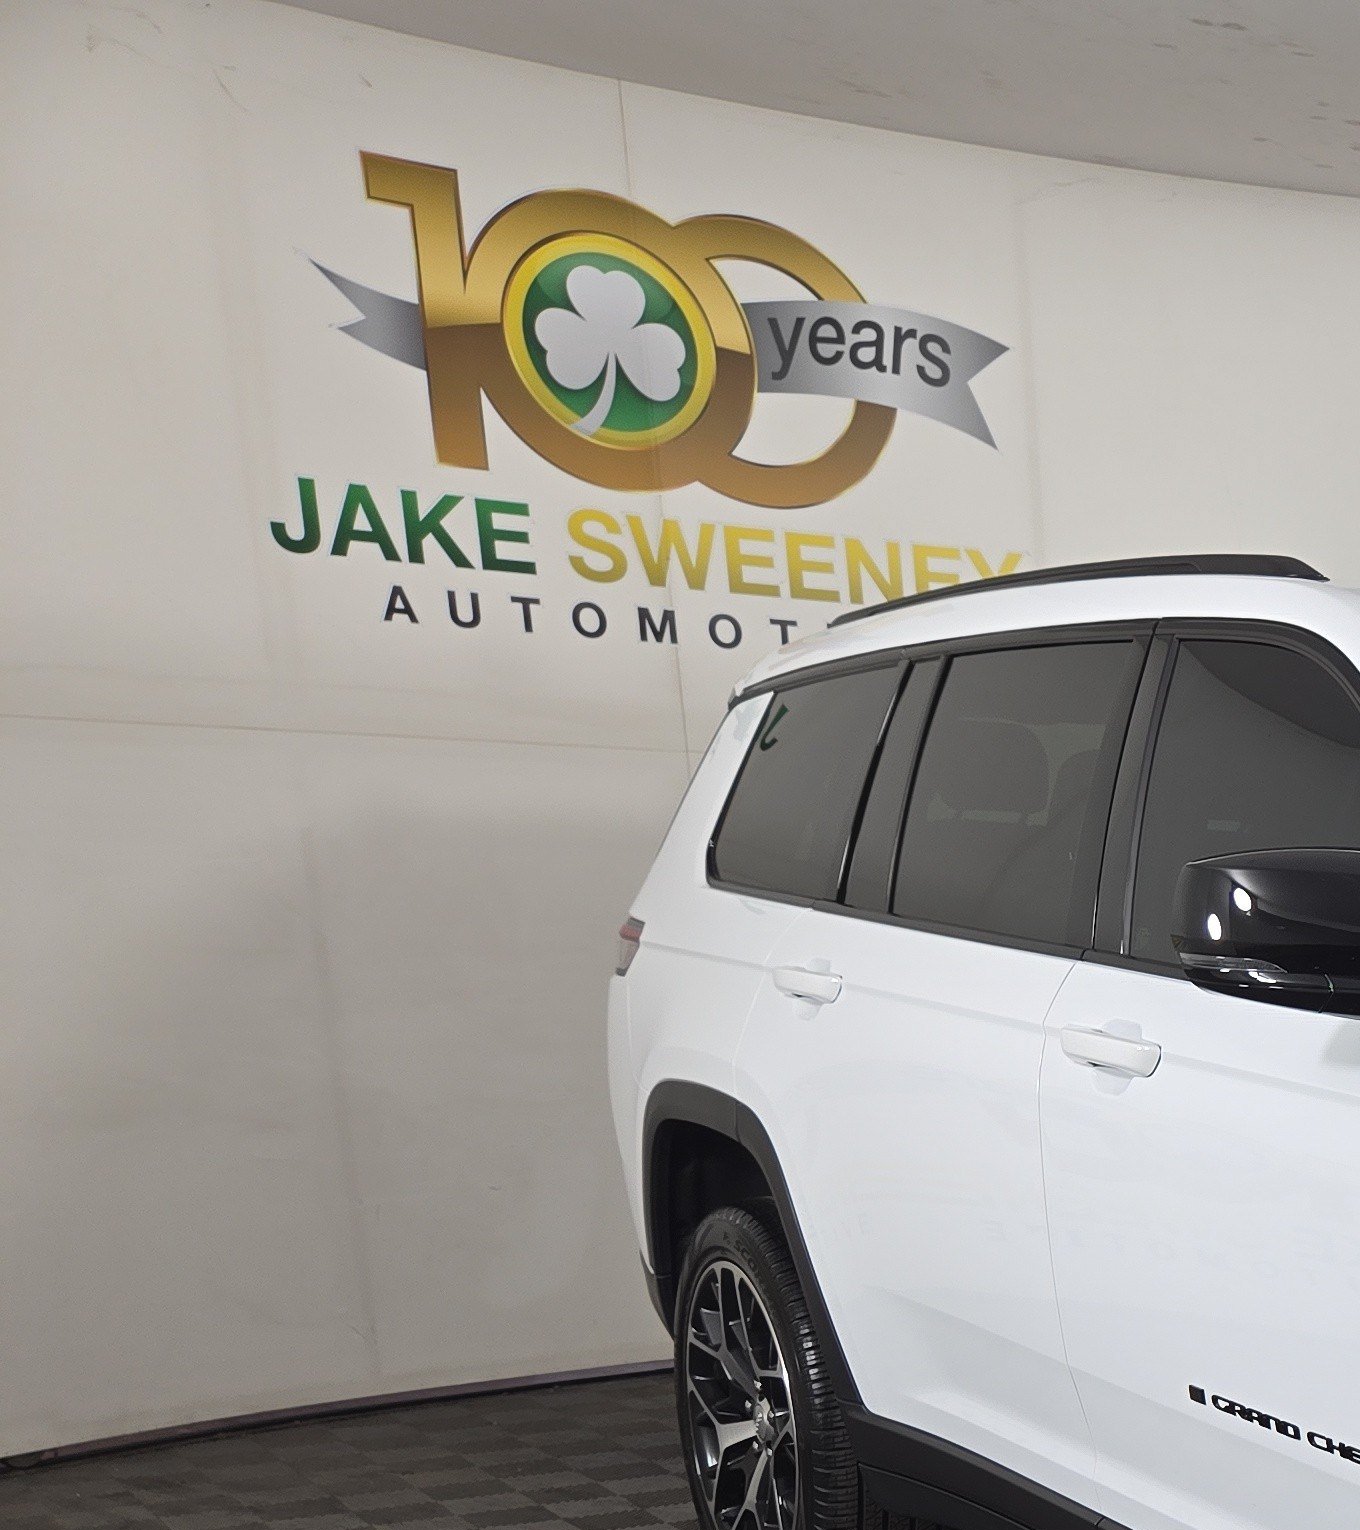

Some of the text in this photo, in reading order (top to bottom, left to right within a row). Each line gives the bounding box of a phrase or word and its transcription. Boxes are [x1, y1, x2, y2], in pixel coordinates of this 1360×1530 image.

[359, 150, 897, 508] 100
[767, 312, 953, 389] years
[270, 477, 537, 576] JAKE
[383, 585, 799, 650] AUTOMOT
[1211, 1394, 1301, 1441] GRAND
